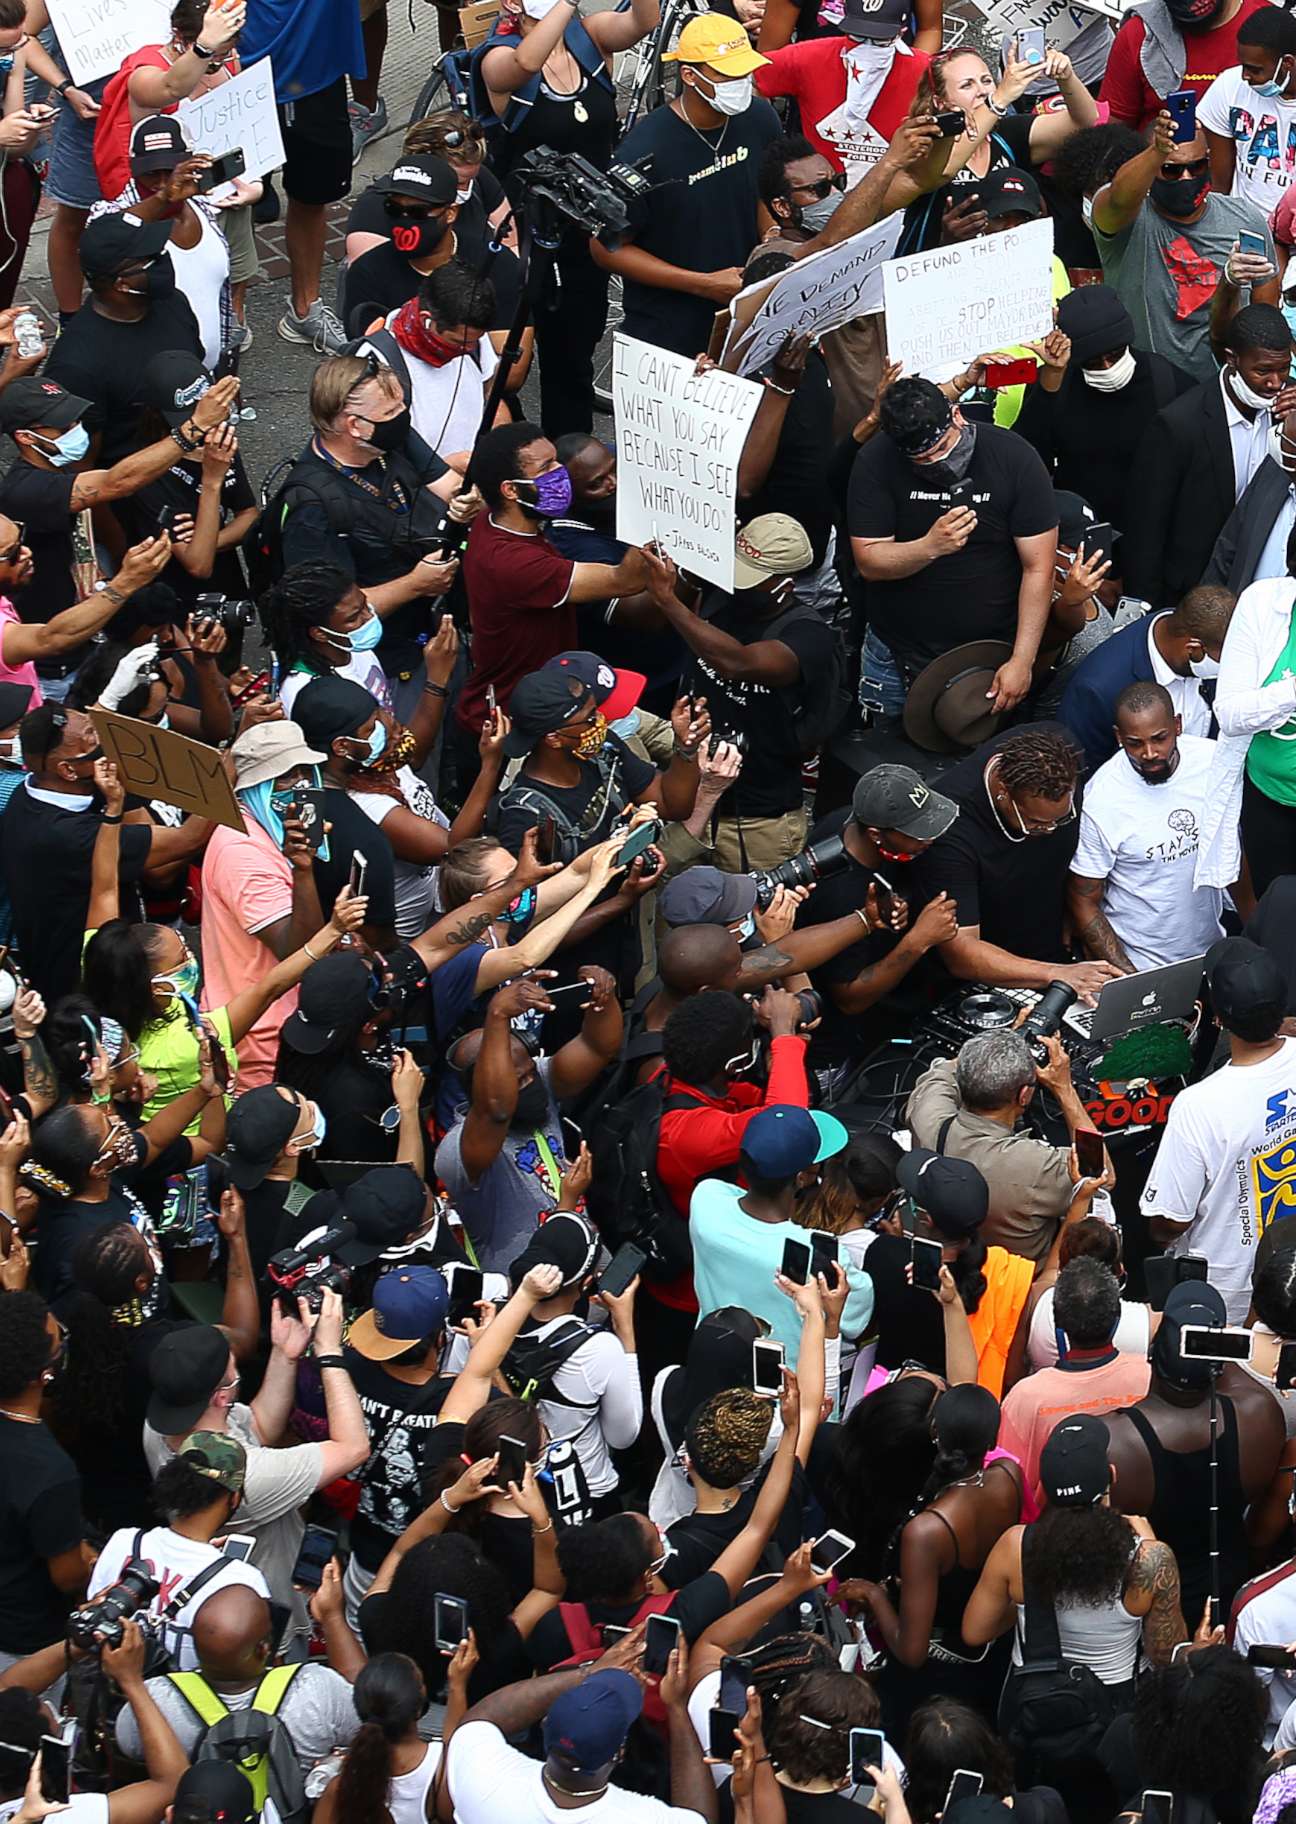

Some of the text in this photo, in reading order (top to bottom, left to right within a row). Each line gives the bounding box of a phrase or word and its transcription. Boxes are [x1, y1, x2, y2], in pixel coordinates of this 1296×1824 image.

[74, 30, 135, 71] Matter
[895, 252, 961, 283] DEFUND
[971, 240, 998, 258] THE
[958, 297, 996, 324] STOP
[938, 339, 972, 359] THEN
[616, 340, 631, 377] I
[683, 374, 756, 422] BELIEVE
[620, 386, 730, 454] WHAT YOU SAY
[623, 429, 734, 499] BECAUSE I SEE
[639, 475, 676, 515] WHAT
[677, 491, 700, 526] YOU
[107, 723, 241, 821] BLM
[1146, 835, 1183, 860] STAY
[1161, 853, 1176, 864] THE
[1251, 1134, 1282, 1155] World
[1235, 1158, 1252, 1246] Special Olympics
[1056, 1484, 1082, 1497] PINK
